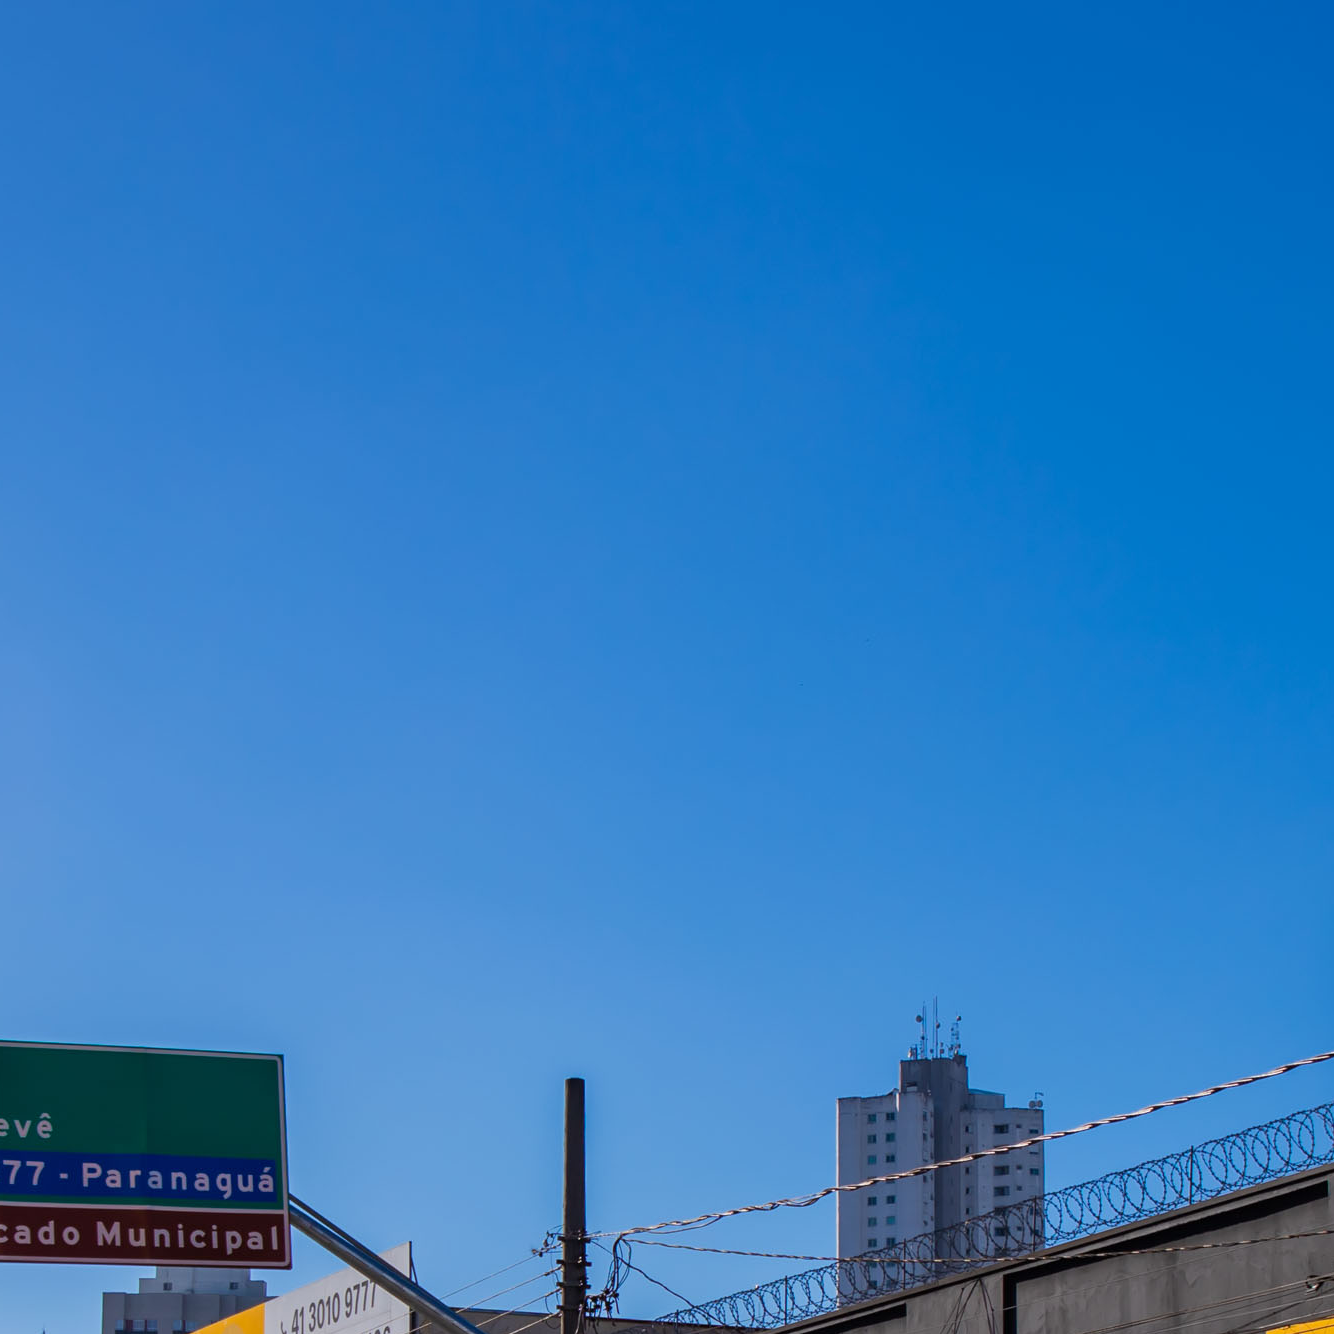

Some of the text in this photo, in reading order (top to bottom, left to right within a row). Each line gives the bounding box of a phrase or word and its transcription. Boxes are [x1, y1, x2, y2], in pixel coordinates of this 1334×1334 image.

[82, 1162, 275, 1199] Paranaguá
[96, 1221, 279, 1256] Municipal
[308, 1292, 341, 1333] 3010
[345, 1279, 378, 1319] 9777
